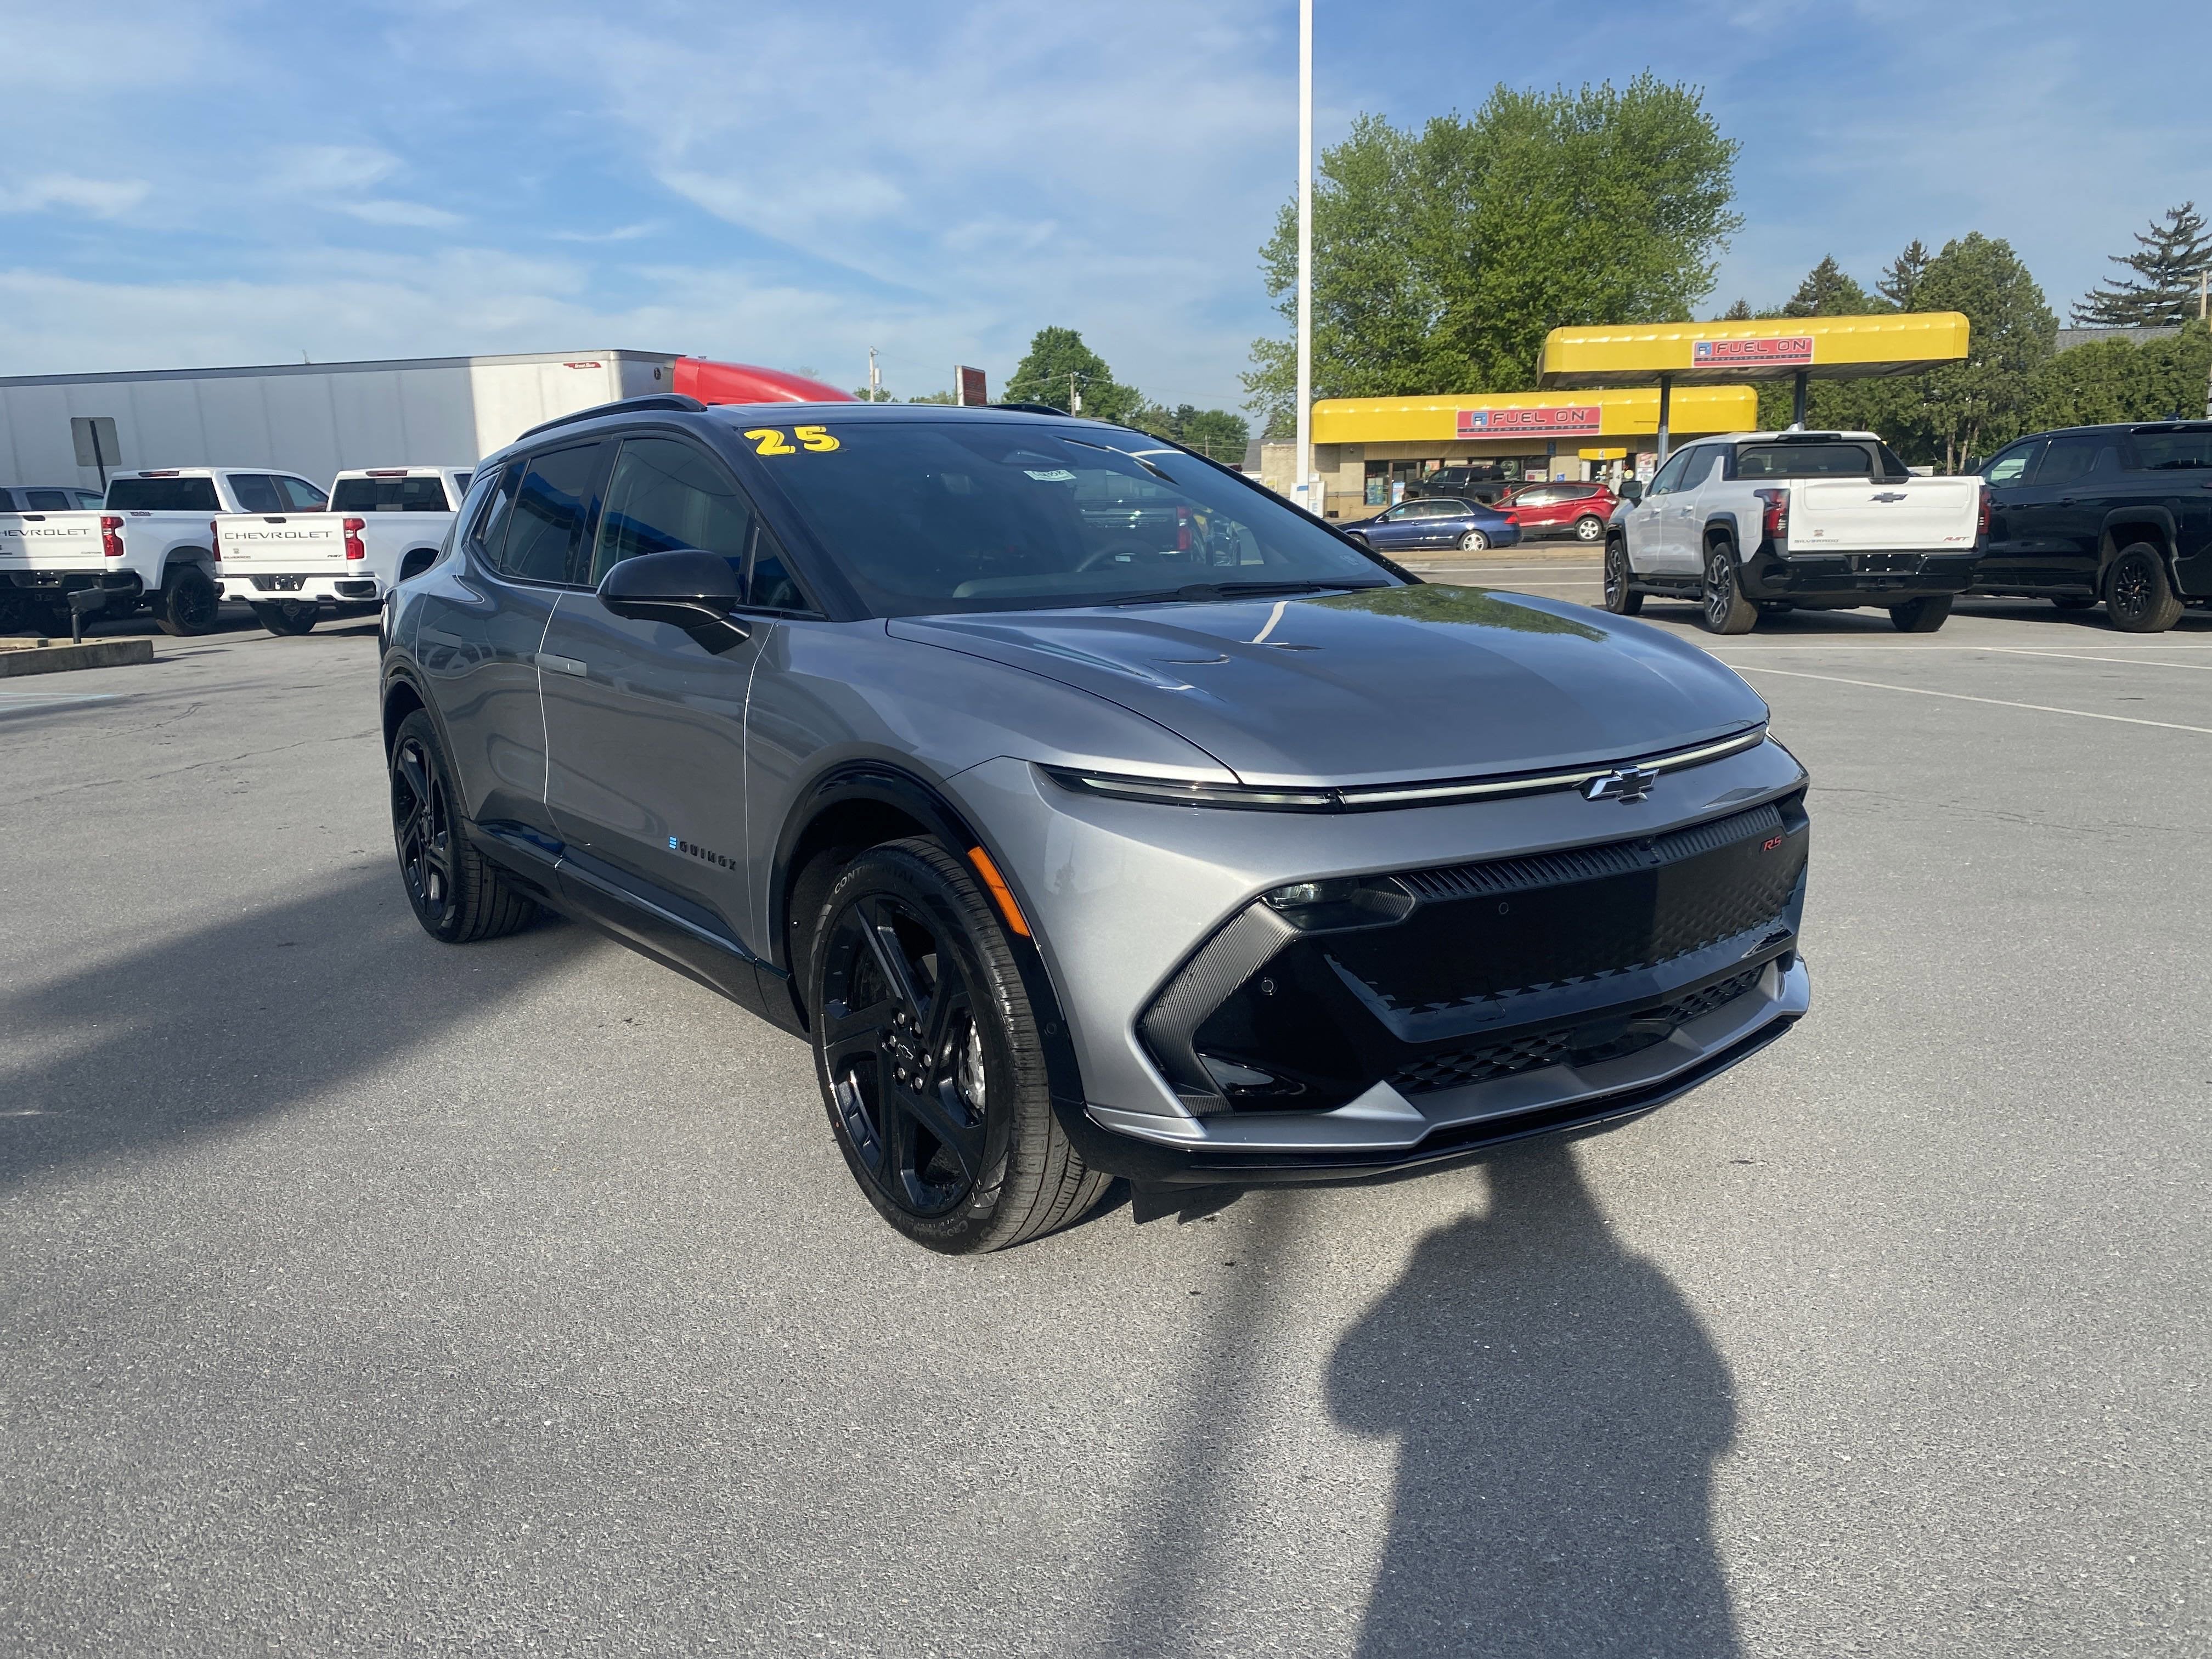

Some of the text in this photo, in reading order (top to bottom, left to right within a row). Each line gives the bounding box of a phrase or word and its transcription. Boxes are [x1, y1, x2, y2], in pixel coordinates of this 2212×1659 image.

[1717, 340, 1805, 353] FUEL ON
[1493, 410, 1584, 424] FUEL ON
[743, 426, 840, 456] 25
[224, 531, 332, 539] CHEVROLET
[1763, 835, 1782, 852] RS
[669, 836, 737, 871] EQUINOX
